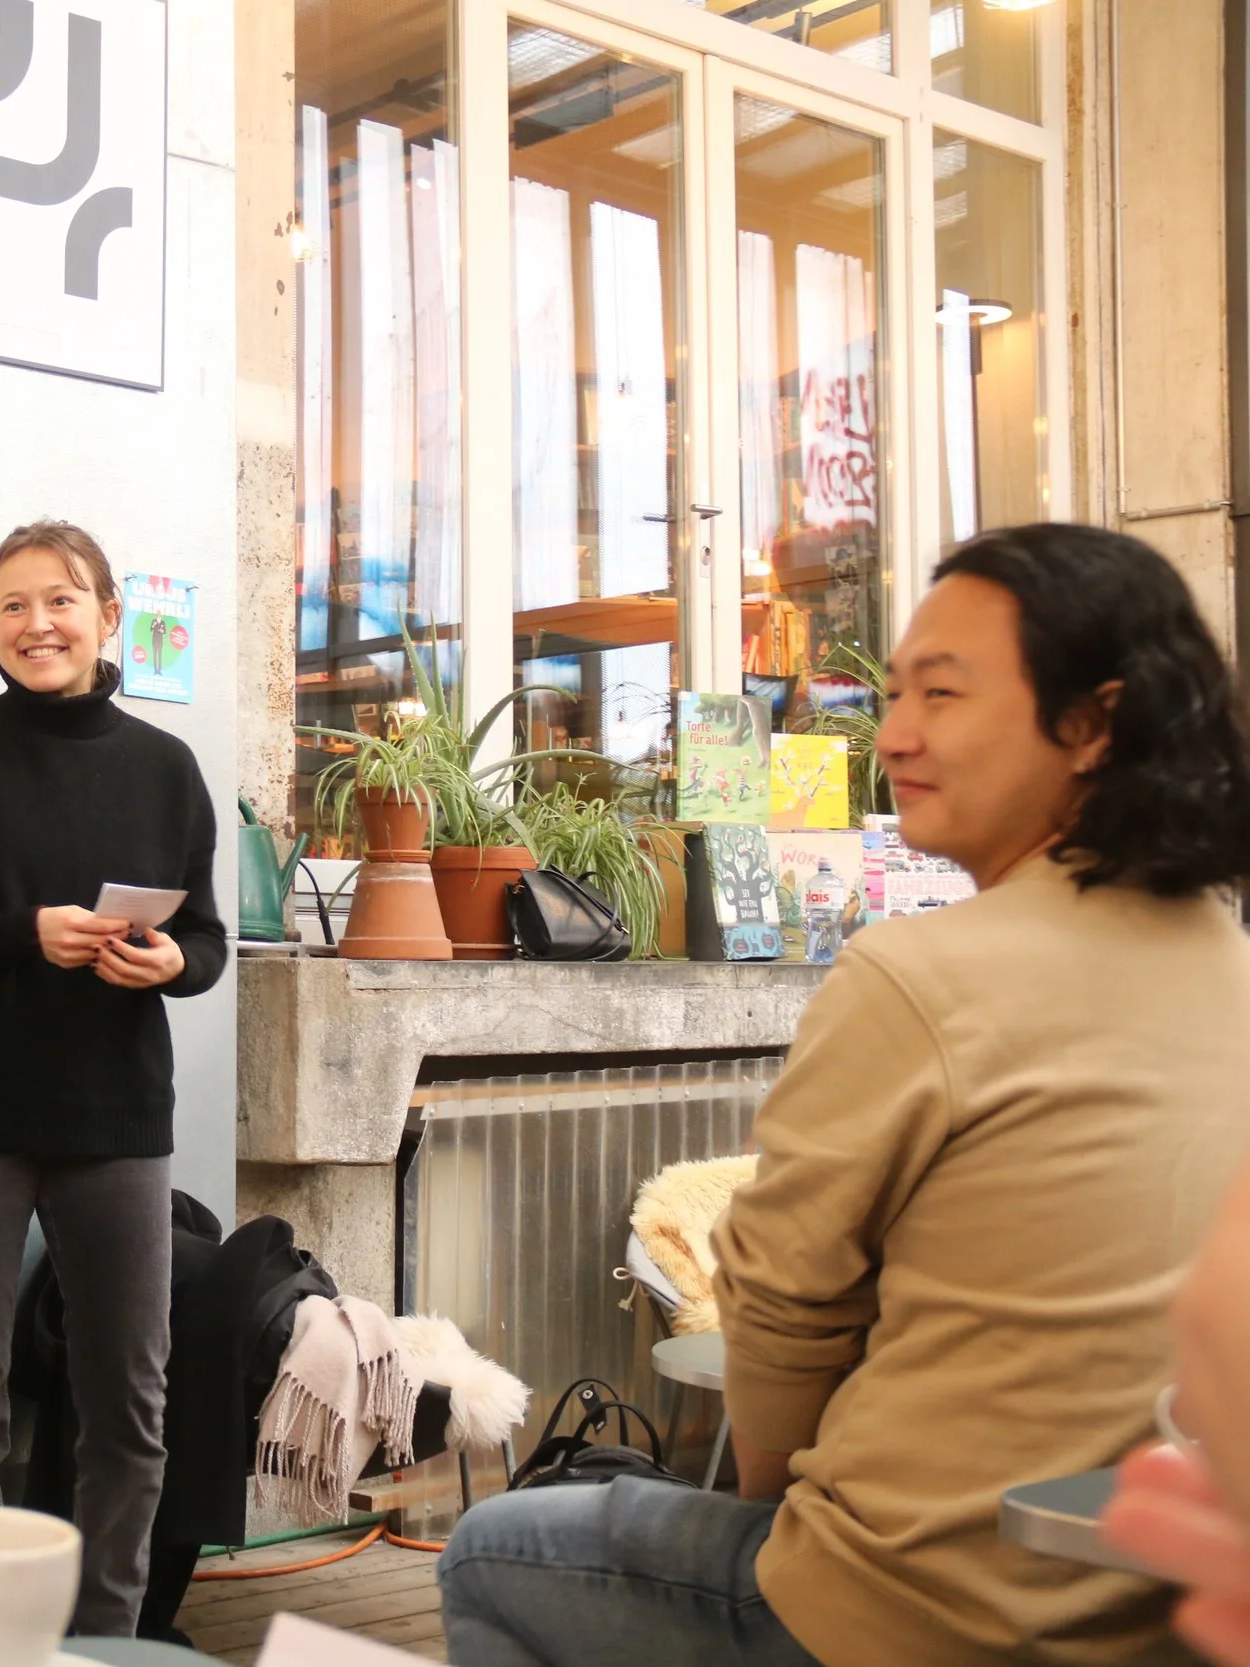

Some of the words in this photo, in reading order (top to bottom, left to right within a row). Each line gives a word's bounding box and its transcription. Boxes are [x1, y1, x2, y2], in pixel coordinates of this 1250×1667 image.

[686, 720, 711, 732] Torte
[690, 732, 704, 745] für
[706, 734, 728, 746] alle!
